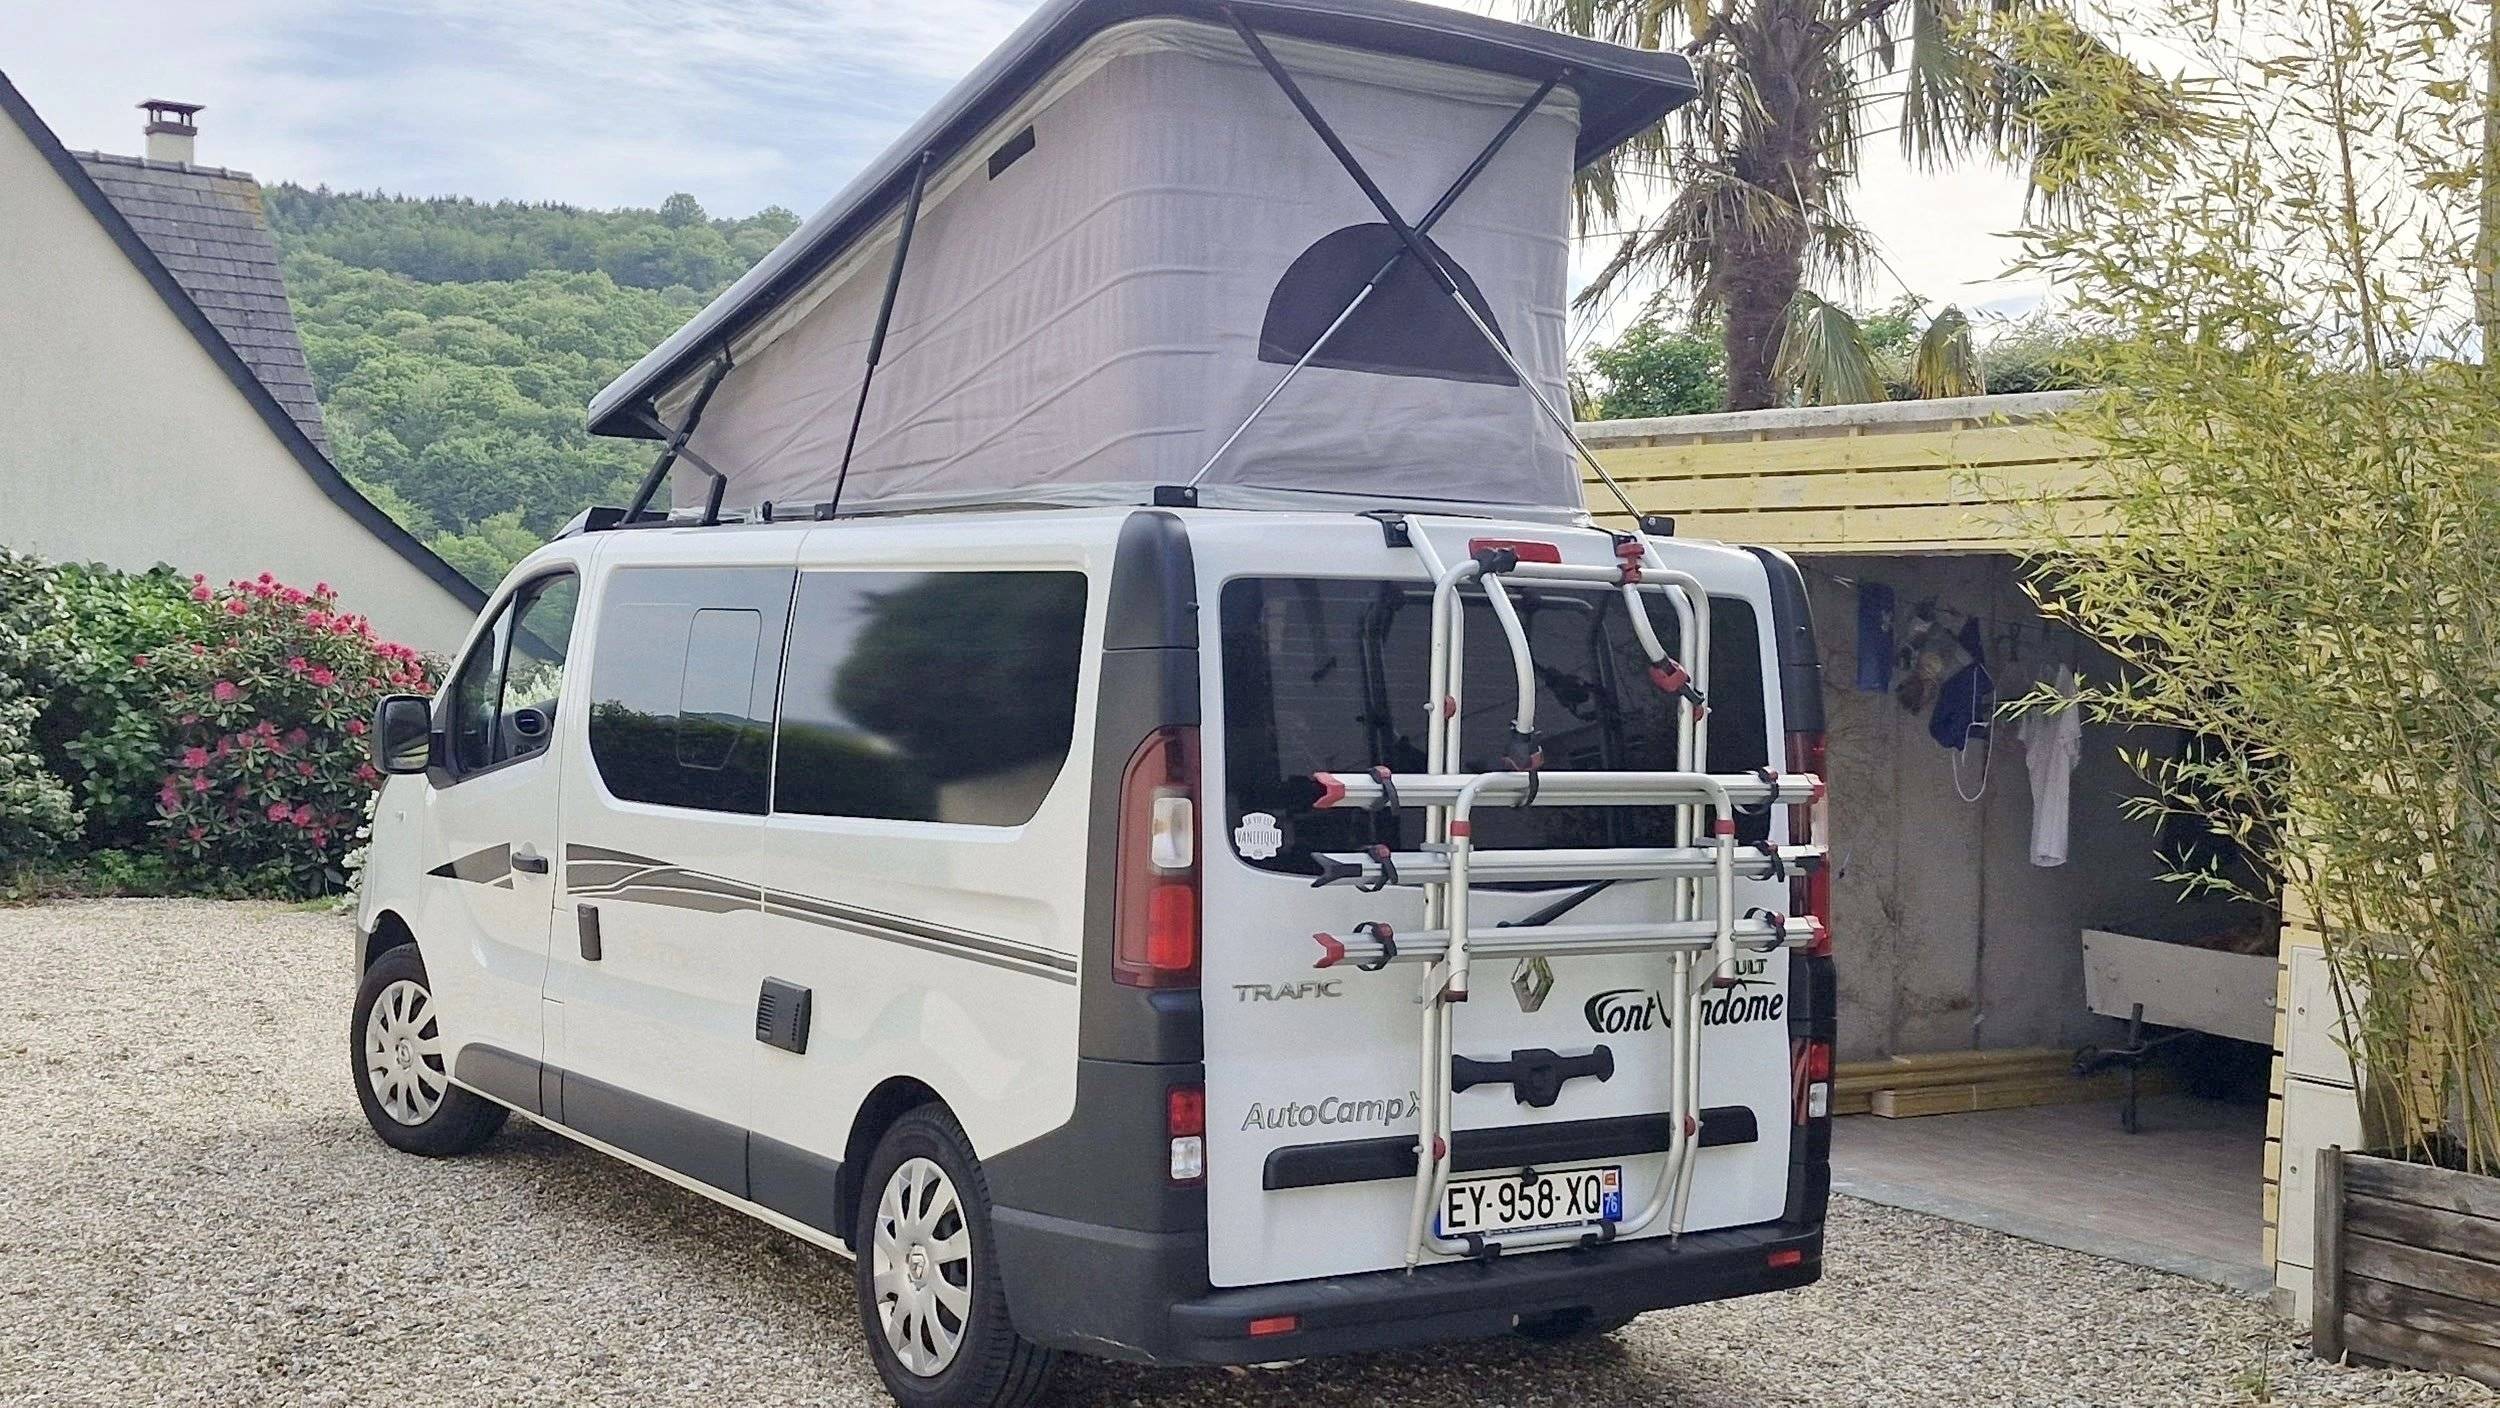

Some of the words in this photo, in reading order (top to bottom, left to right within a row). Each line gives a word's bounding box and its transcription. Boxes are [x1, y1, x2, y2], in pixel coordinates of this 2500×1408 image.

[1232, 978, 1343, 1002] TRAFIC
[1447, 1174, 1601, 1229] EY-958-XQ
[1604, 1195, 1618, 1215] 76
